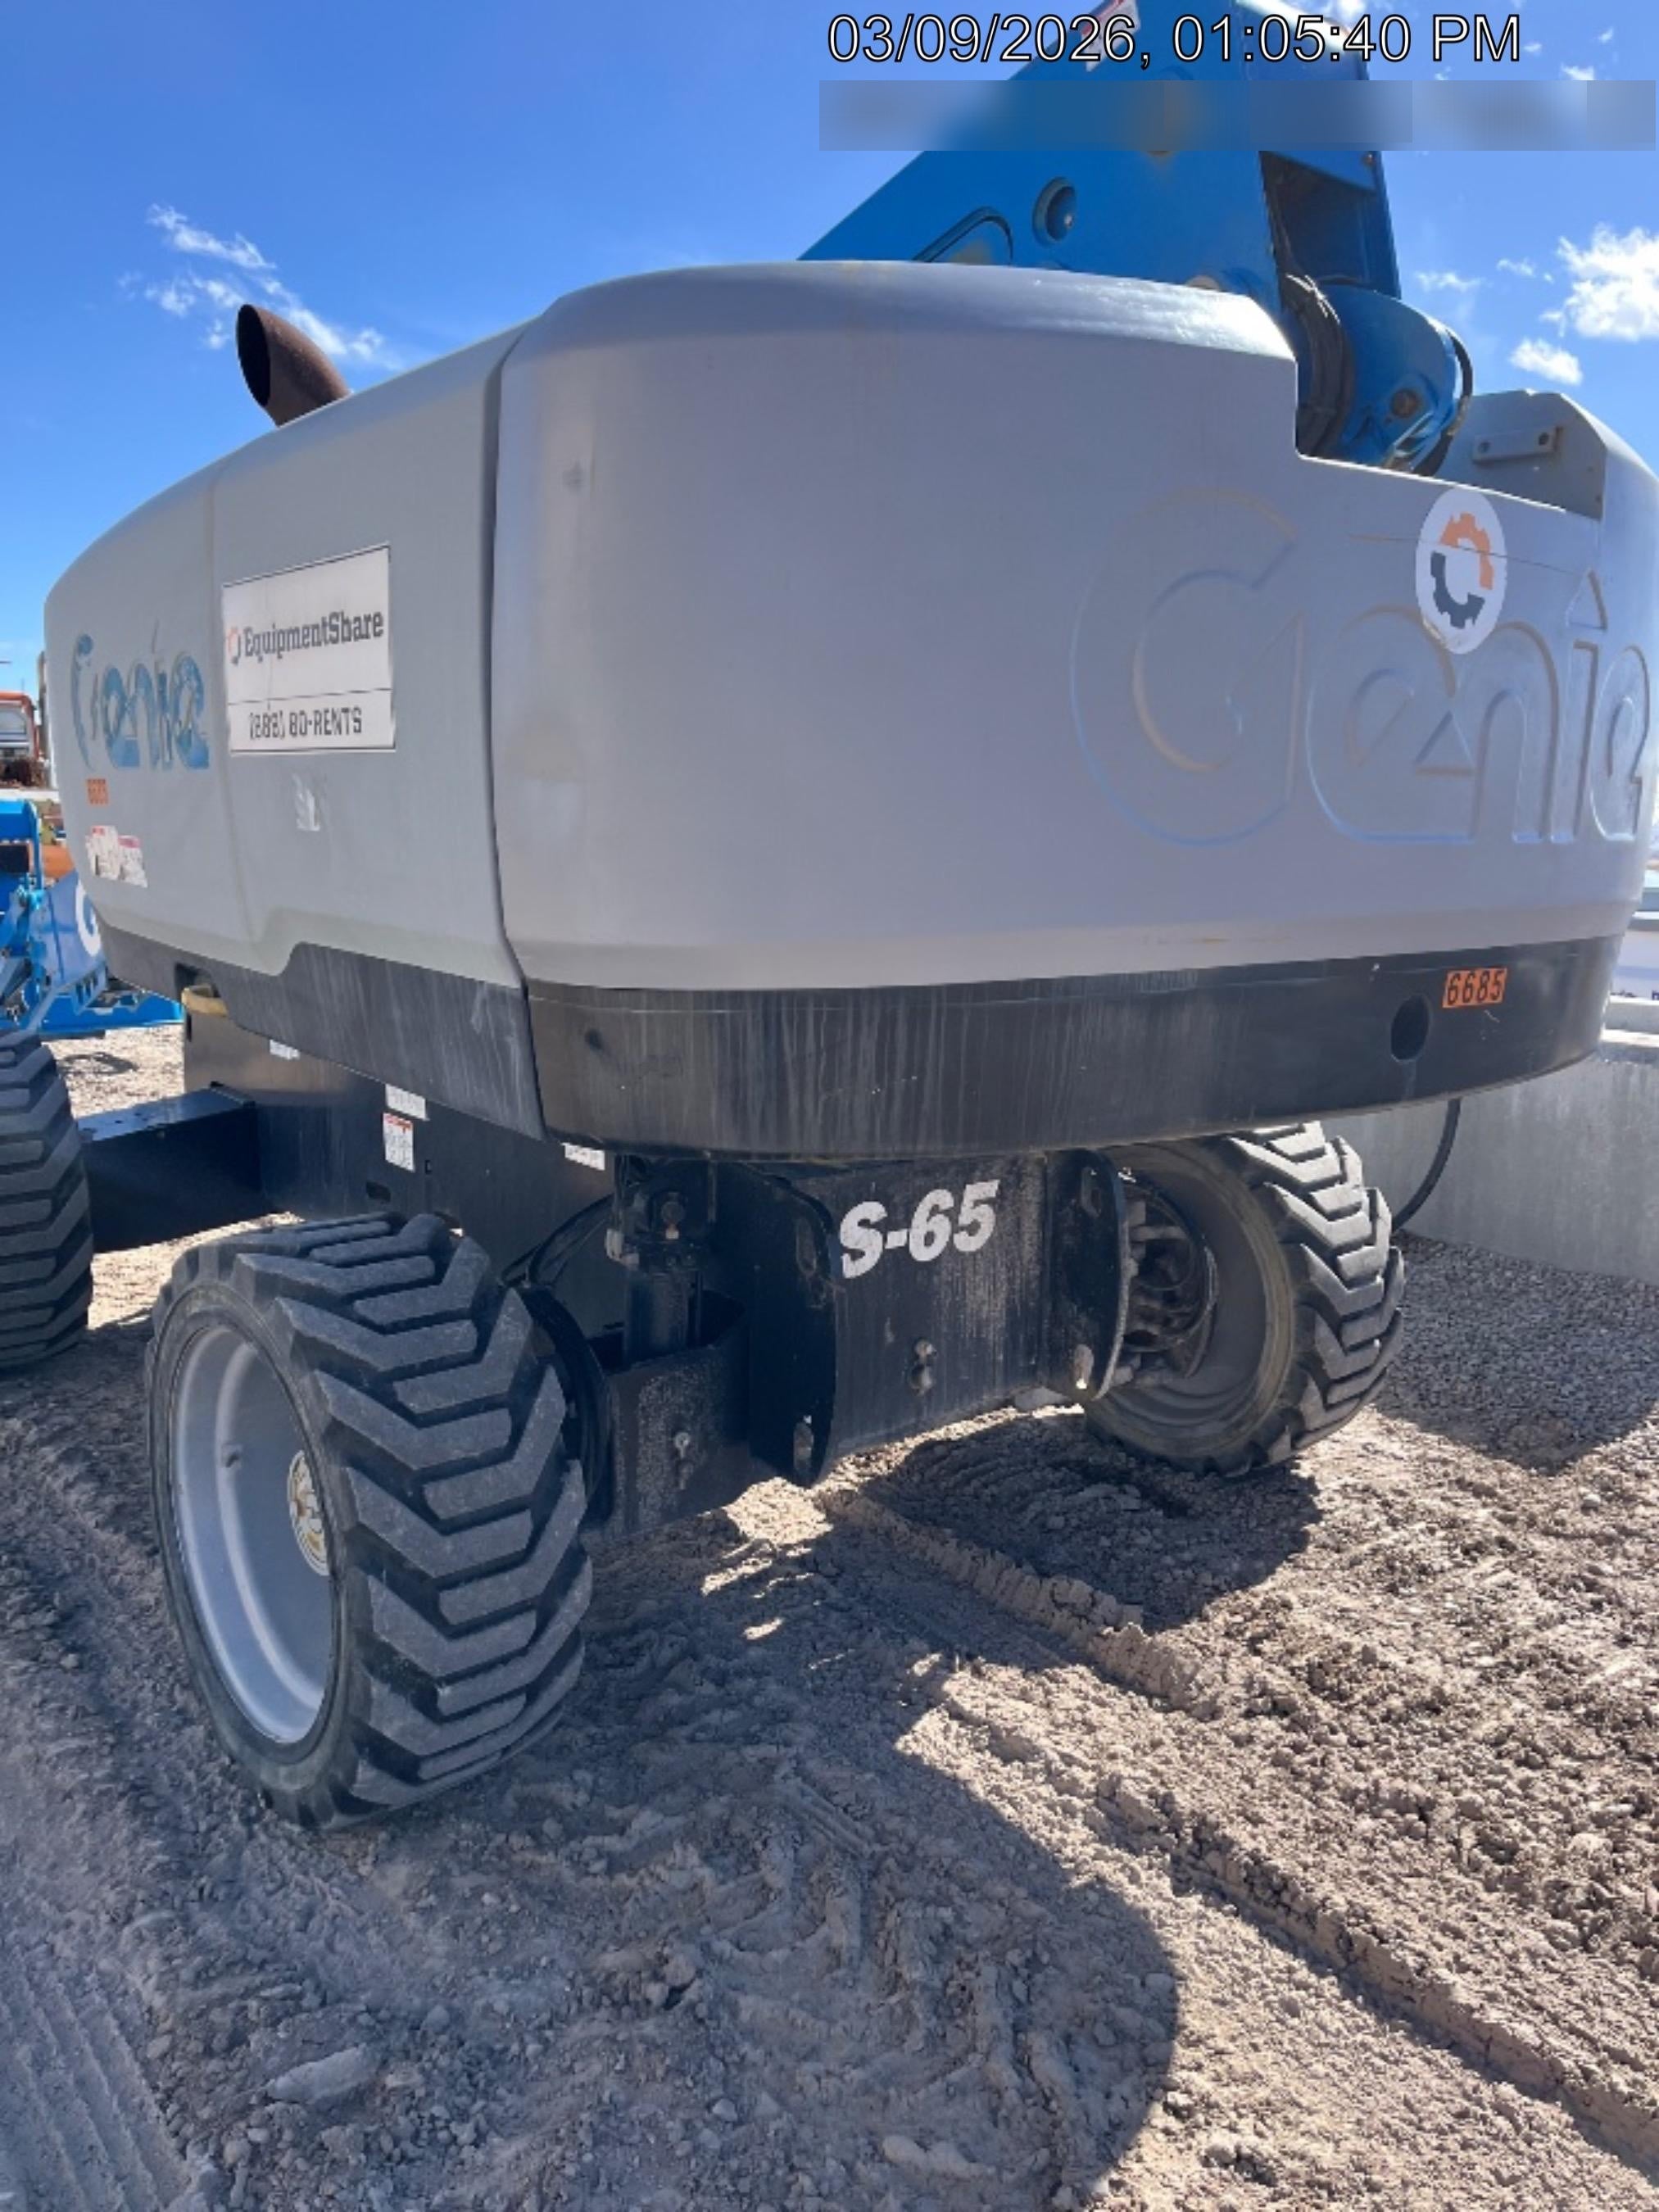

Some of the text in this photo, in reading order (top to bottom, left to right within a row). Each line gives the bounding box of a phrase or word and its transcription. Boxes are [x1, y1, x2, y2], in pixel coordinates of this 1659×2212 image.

[243, 610, 384, 664] EquipmentShare
[1071, 487, 1650, 847] Genie
[289, 706, 362, 737] 80-RENTS
[1447, 969, 1506, 1006] 6685
[840, 1179, 1000, 1279] S-65
